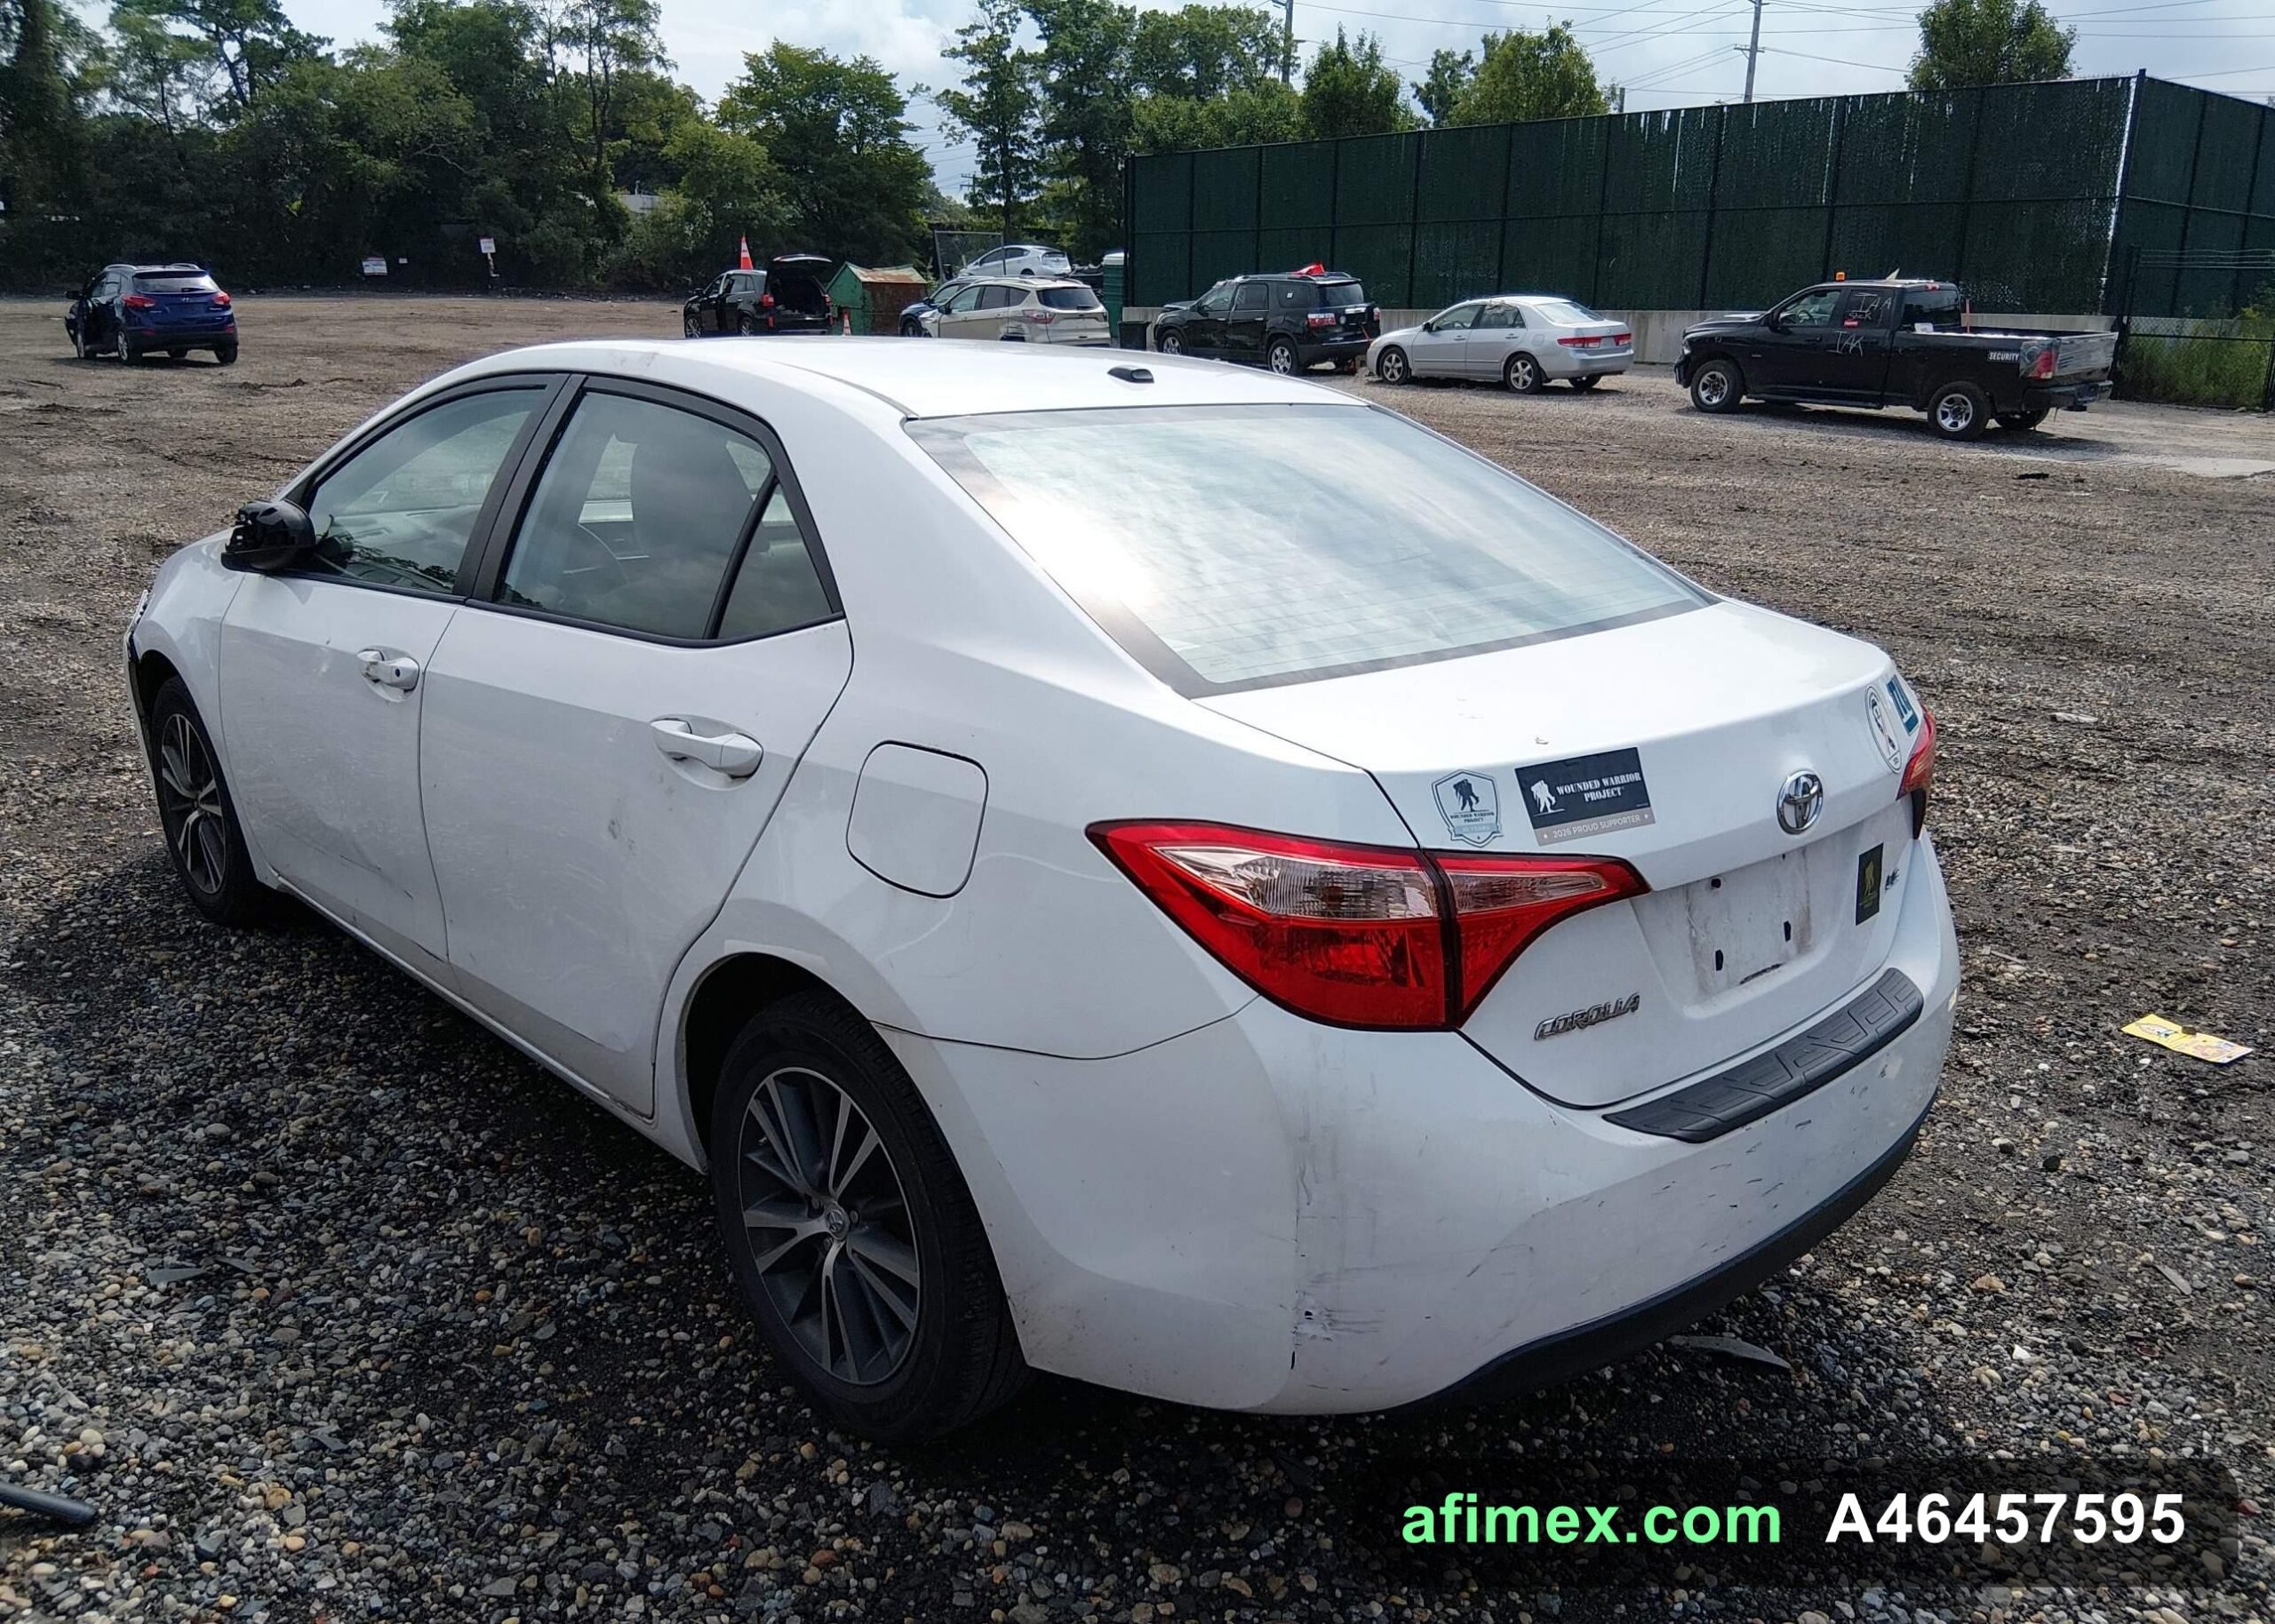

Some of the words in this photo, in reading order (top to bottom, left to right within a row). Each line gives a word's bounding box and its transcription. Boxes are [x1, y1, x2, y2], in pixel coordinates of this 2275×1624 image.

[1989, 352, 2019, 362] SECURITY
[1556, 778, 1600, 796] WOUNDED
[1601, 772, 1642, 789] WARRIOR
[1584, 786, 1623, 802] PROJECT
[1572, 823, 1599, 834] PROUD
[1600, 814, 1641, 830] SUPPORTER
[1534, 992, 1640, 1040] COROLLA
